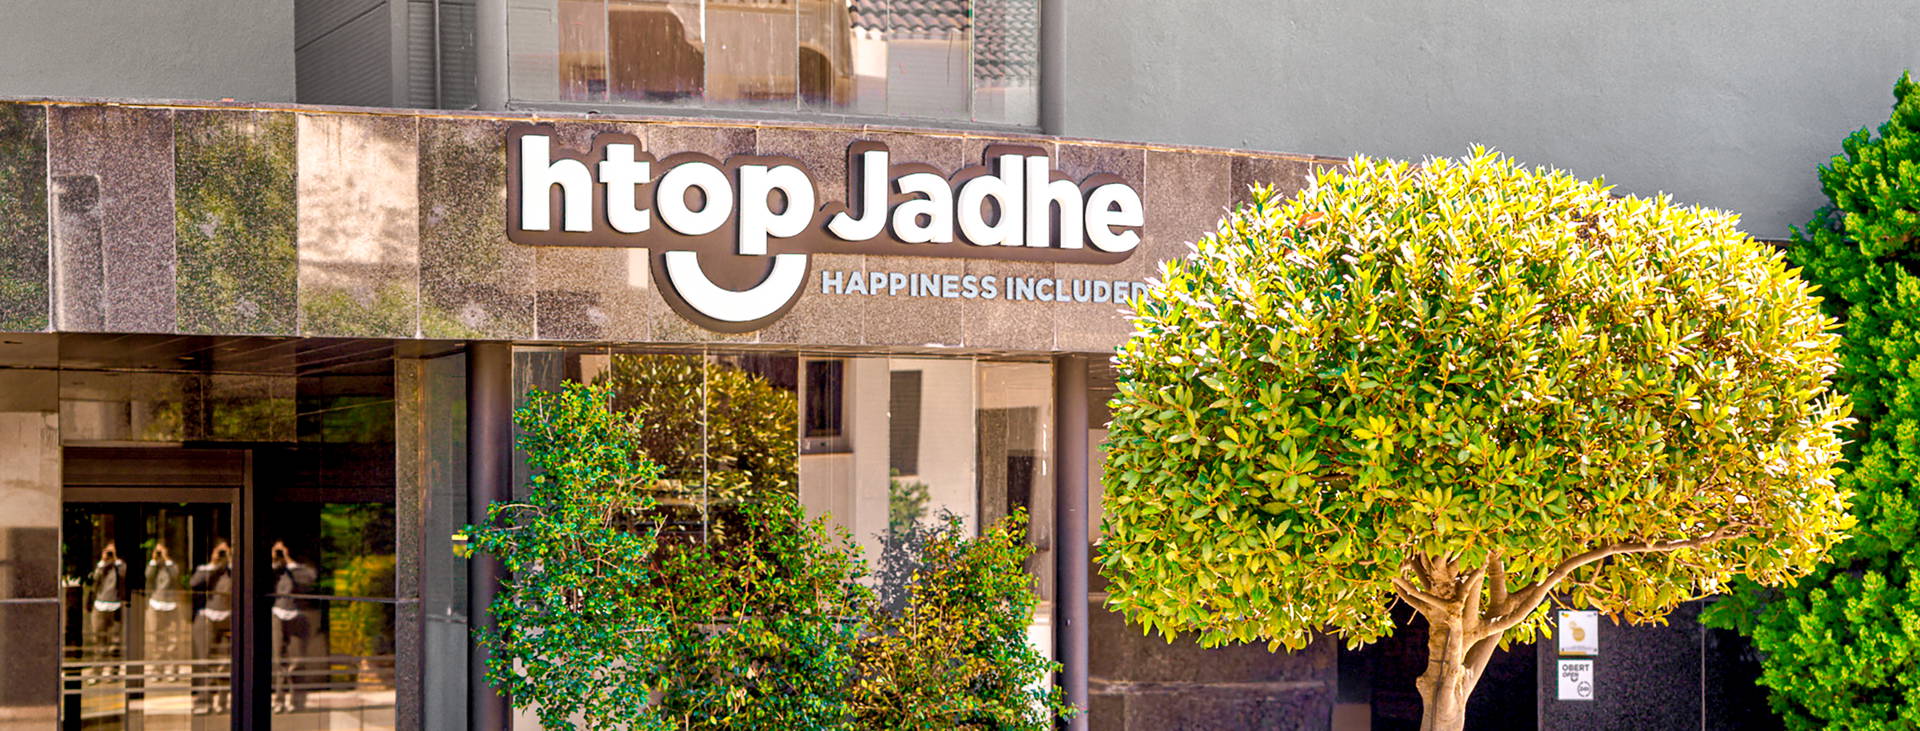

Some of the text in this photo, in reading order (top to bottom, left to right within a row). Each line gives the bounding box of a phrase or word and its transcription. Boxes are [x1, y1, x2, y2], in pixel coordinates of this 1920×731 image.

[521, 135, 1145, 255] htop Jadhe
[821, 270, 1149, 304] HAPPINESS INCLUDED
[1562, 663, 1590, 672] OBERT
